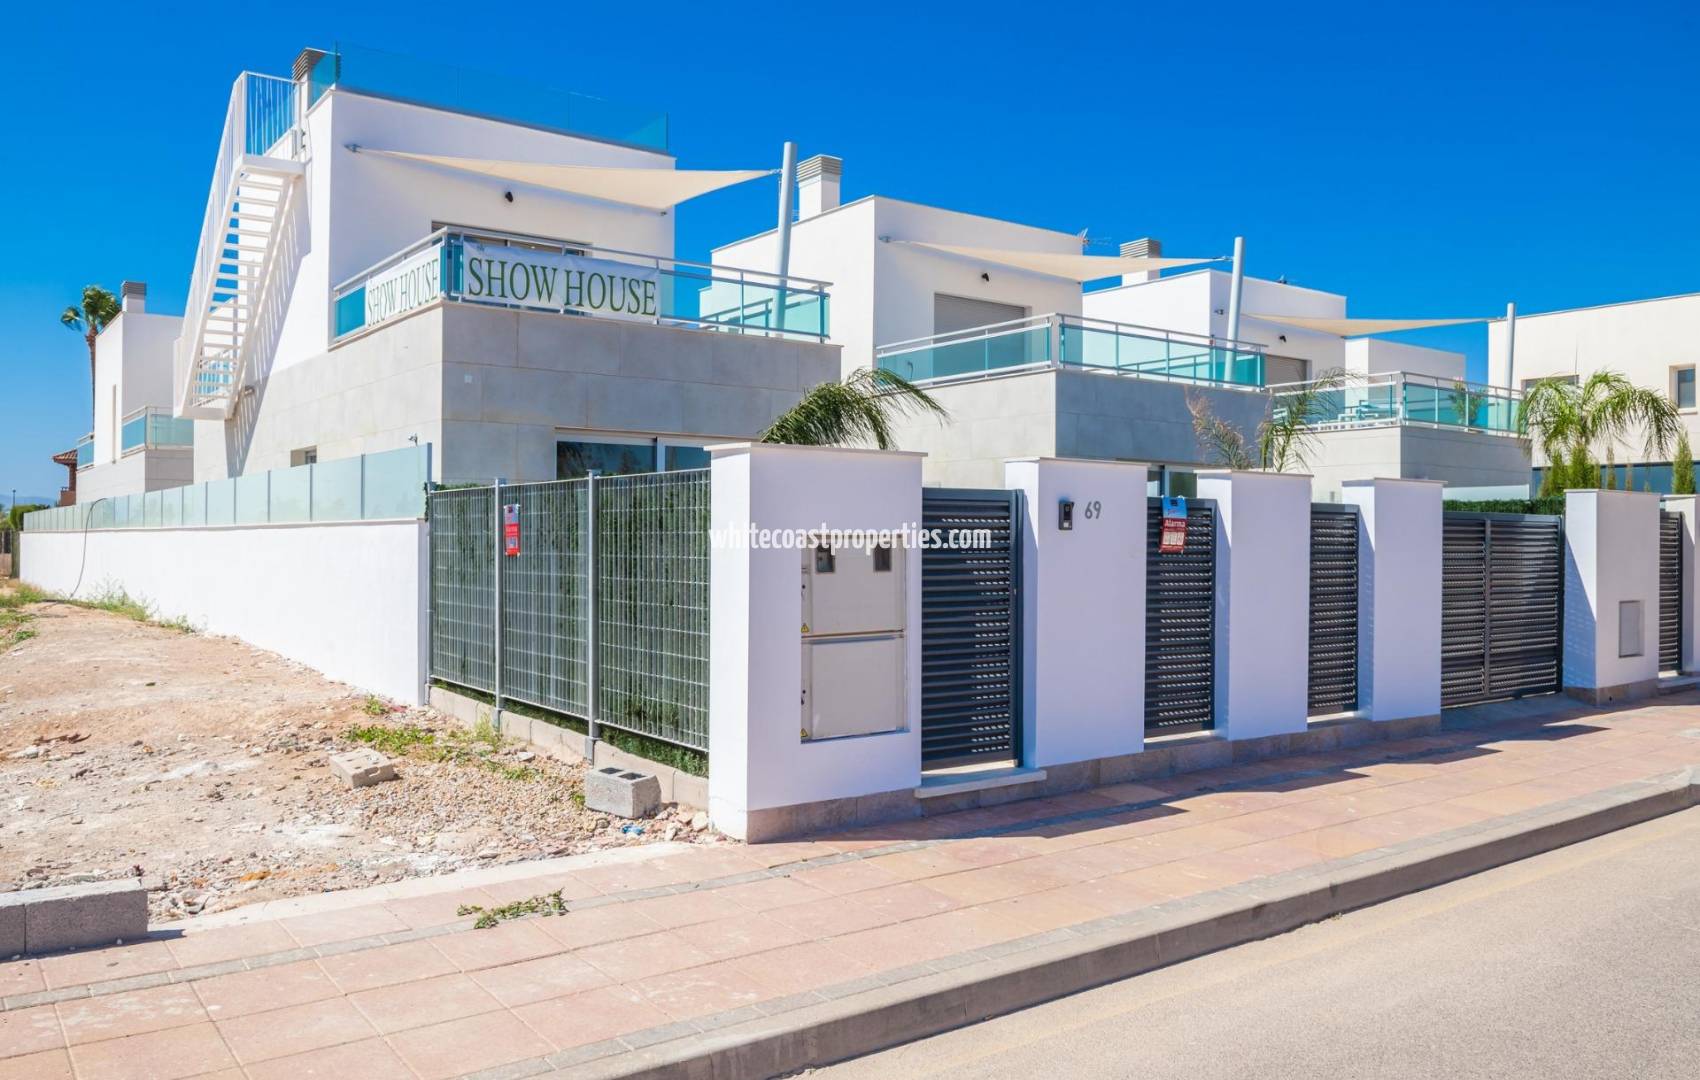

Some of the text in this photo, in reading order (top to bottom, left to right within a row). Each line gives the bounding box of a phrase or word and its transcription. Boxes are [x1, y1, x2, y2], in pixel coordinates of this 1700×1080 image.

[367, 258, 439, 327] SHOW HOUSE
[468, 257, 657, 316] SHOW HOUSE
[1085, 500, 1101, 519] 69
